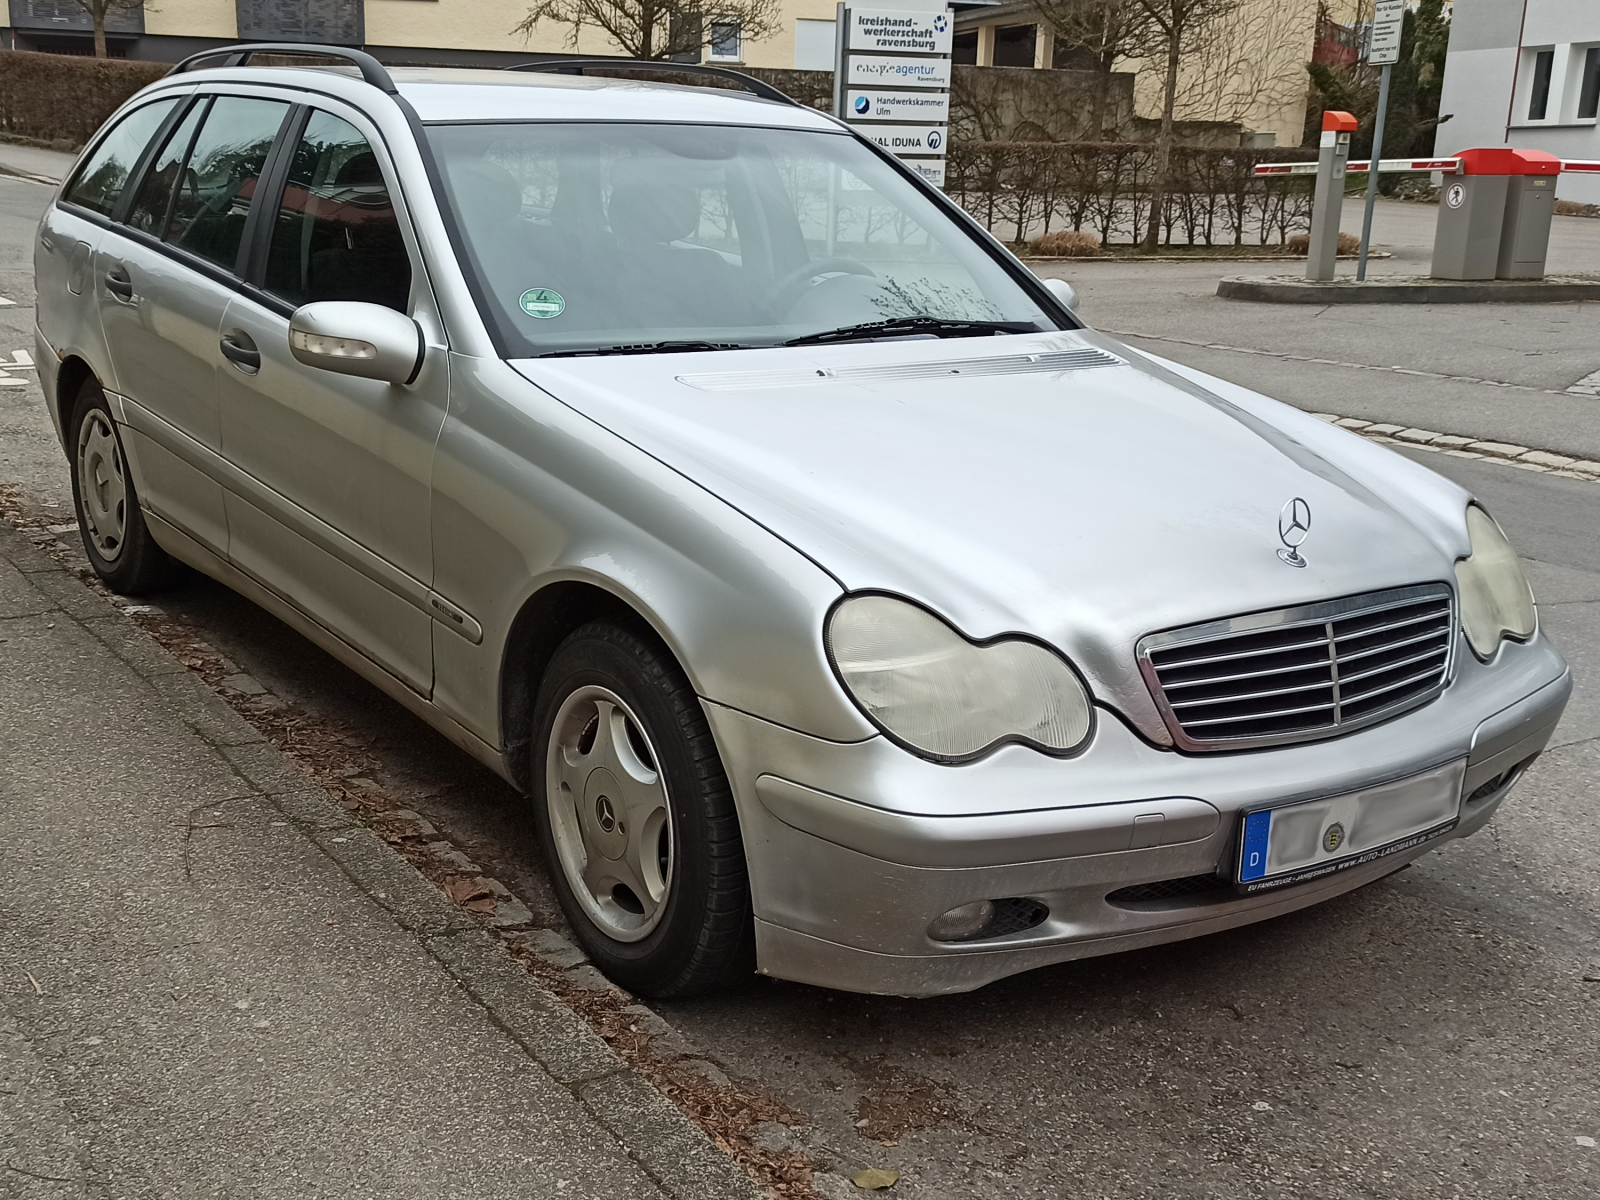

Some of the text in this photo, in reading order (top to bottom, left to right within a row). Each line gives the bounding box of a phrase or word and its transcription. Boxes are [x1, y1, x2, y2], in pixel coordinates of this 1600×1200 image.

[858, 16, 918, 27] kreishand-
[863, 27, 933, 38] werkerschaft
[876, 38, 936, 51] ravensburg
[876, 97, 945, 107] Handwerkskammer
[876, 107, 891, 116] Ulm
[891, 137, 922, 148] IDUNA
[1250, 852, 1259, 867] D
[1247, 884, 1257, 892] EU
[1257, 876, 1293, 890] FAHRZEUGE
